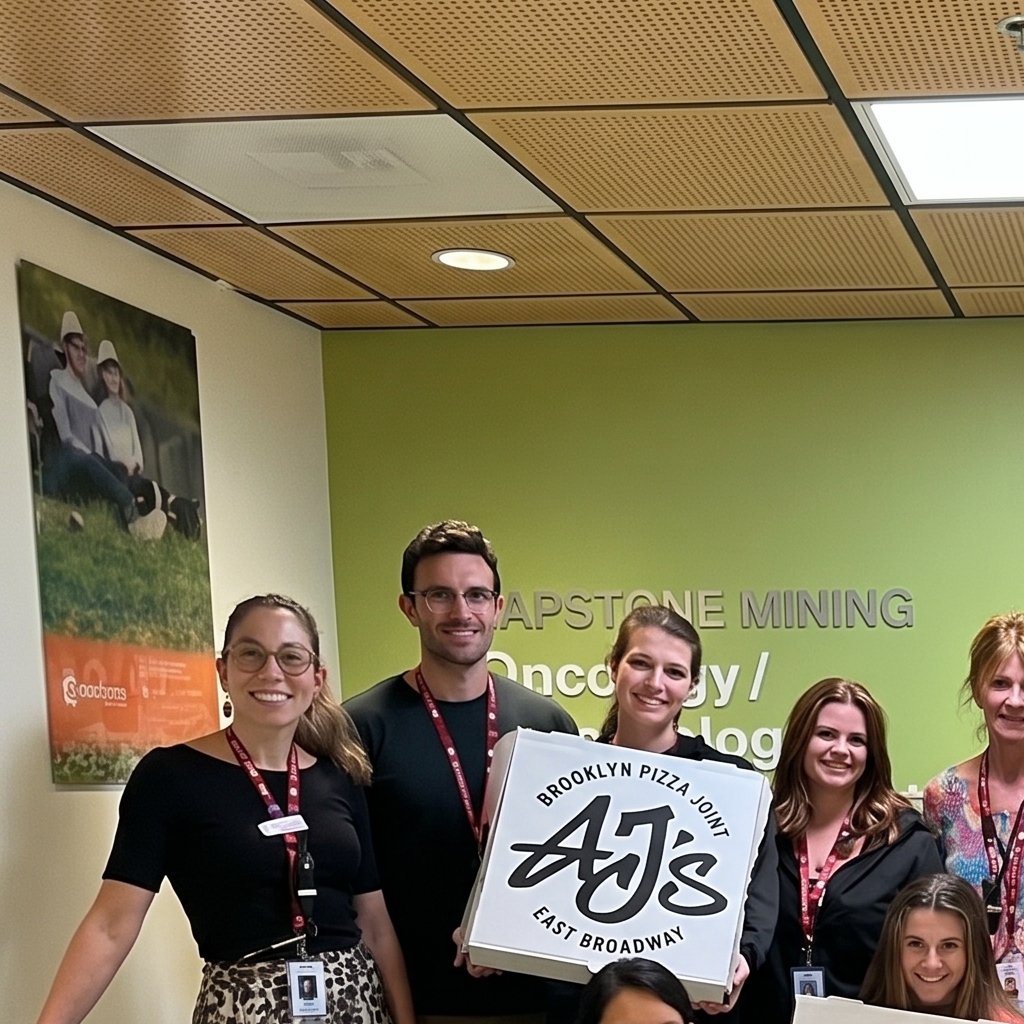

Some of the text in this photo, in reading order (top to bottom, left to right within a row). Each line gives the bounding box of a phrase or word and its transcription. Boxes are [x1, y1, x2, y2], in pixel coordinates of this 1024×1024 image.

[494, 588, 915, 630] APSTONE MINING
[486, 650, 740, 708] Oncogy
[536, 762, 730, 839] BROOKLYN PIZZA JOINT
[532, 906, 684, 954] EAST BROADWAY
